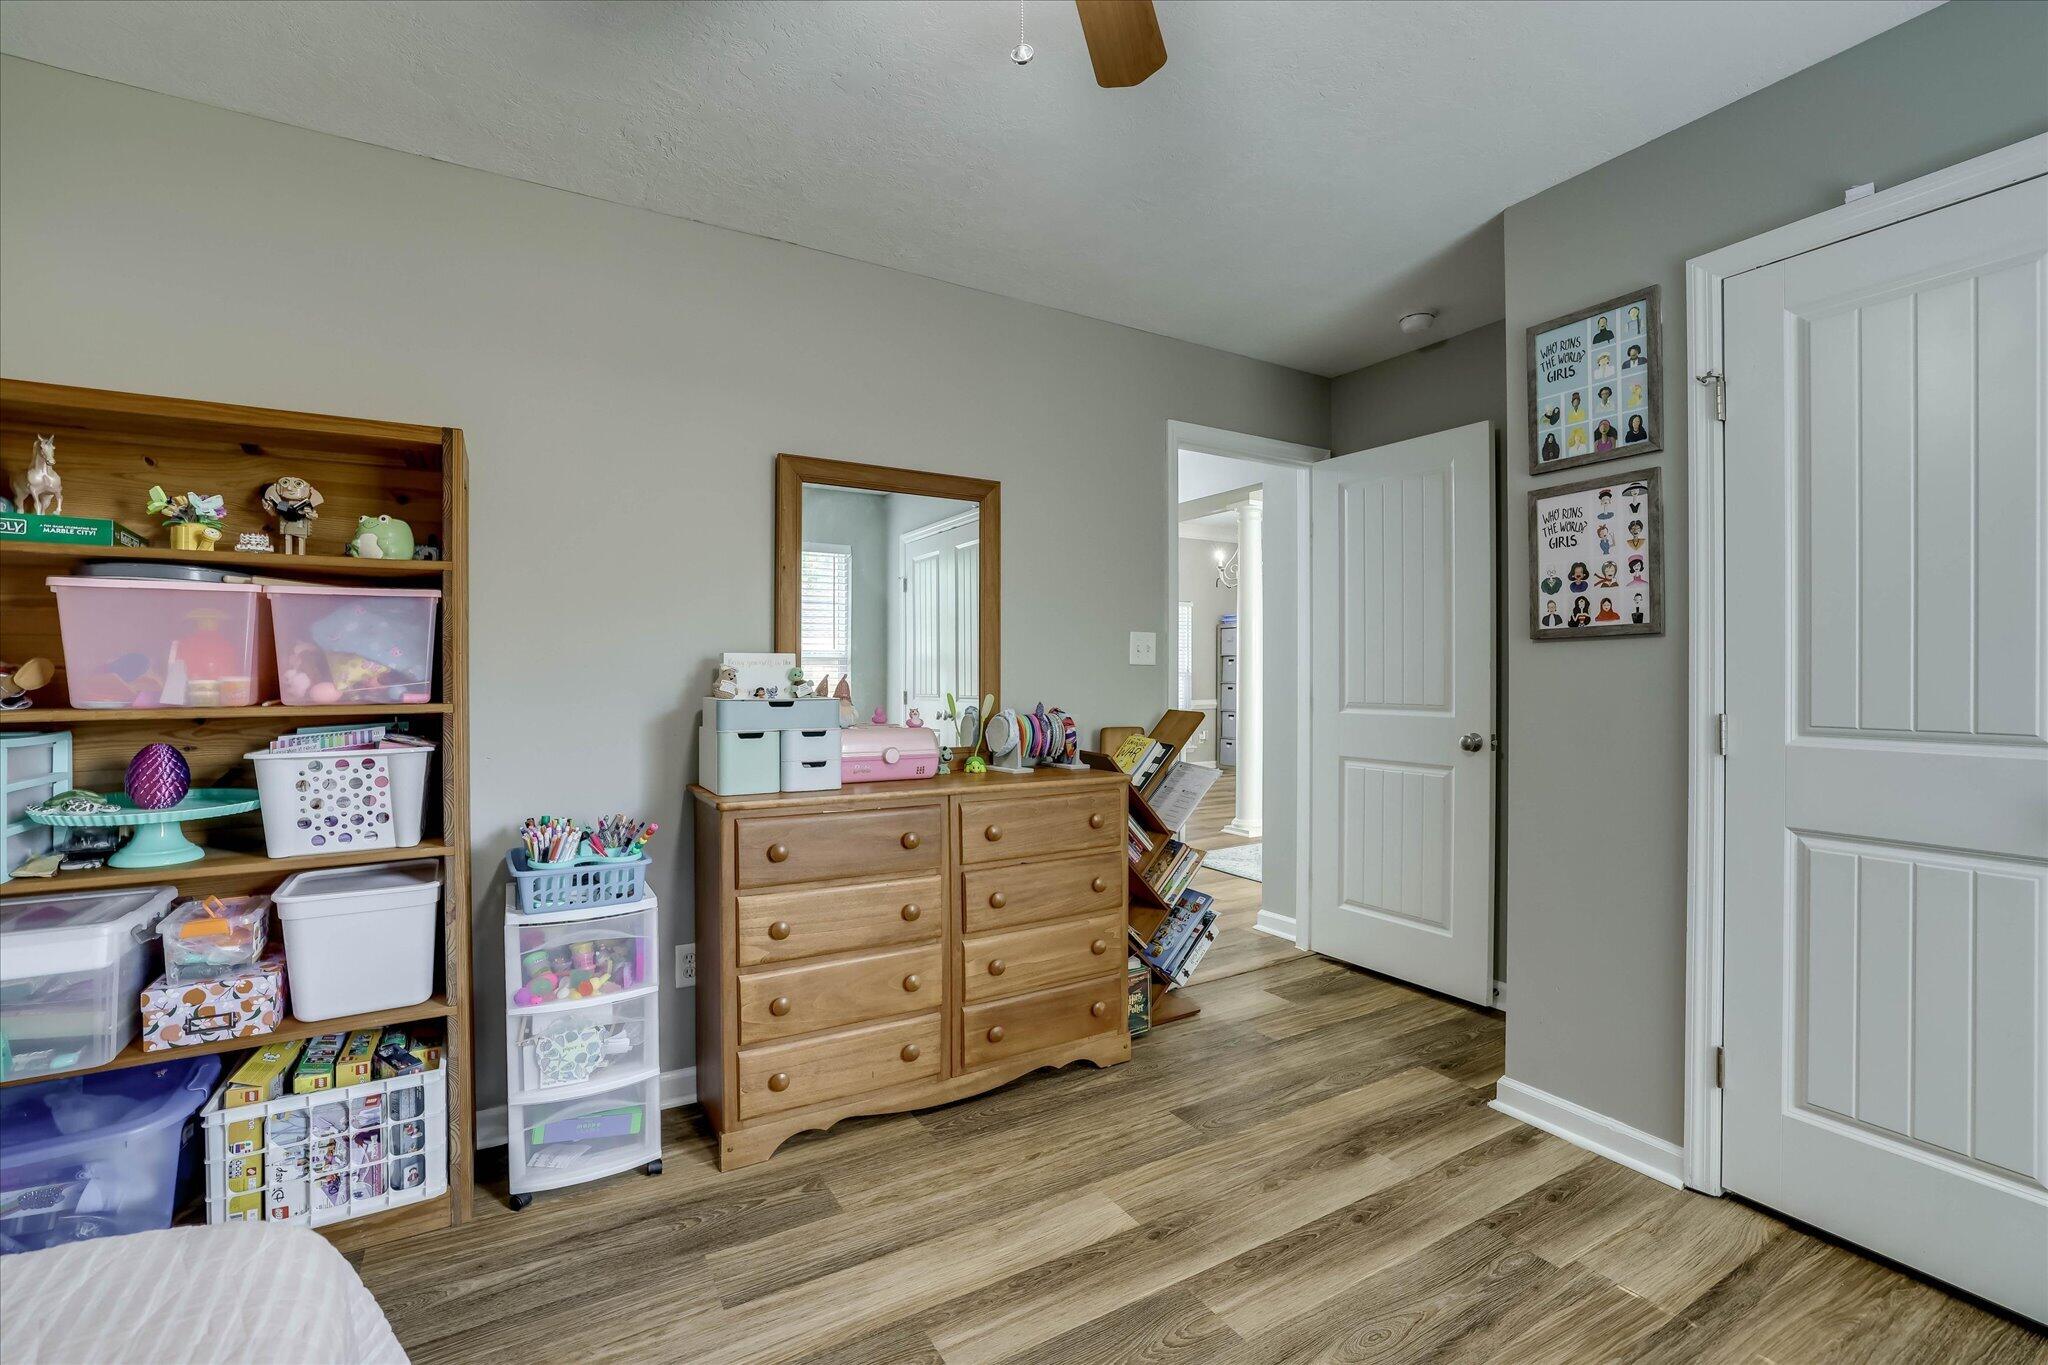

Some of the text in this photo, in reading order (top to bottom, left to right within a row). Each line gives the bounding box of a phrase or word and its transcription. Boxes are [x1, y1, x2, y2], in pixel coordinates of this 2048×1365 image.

[1540, 336, 1581, 359] WHO RUNS
[1540, 350, 1586, 372] THE WORLD?
[1547, 365, 1576, 383] GIRLS
[1542, 507, 1583, 524] WHO RUNS
[42, 527, 75, 535] MARBLE
[1542, 521, 1588, 537] THE WORLD?
[1549, 534, 1577, 549] GIRLS
[1116, 747, 1142, 763] WAR
[1129, 992, 1144, 1005] Harry
